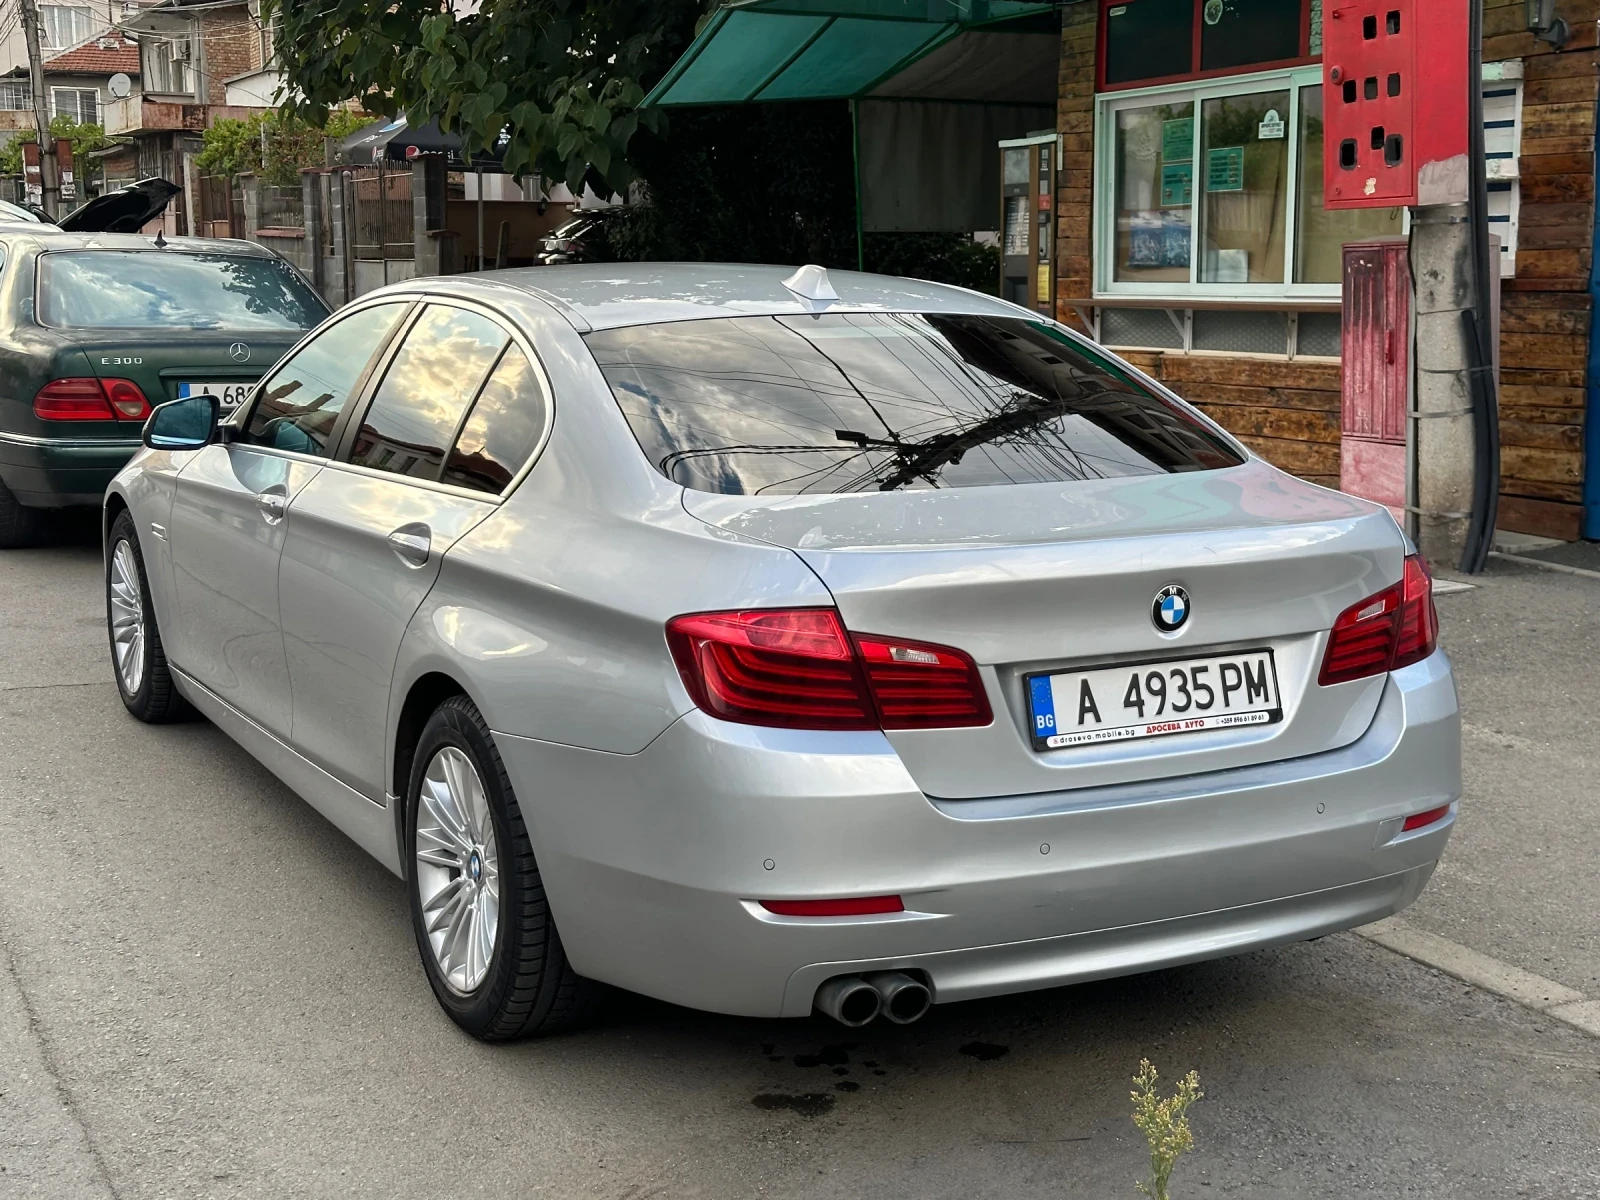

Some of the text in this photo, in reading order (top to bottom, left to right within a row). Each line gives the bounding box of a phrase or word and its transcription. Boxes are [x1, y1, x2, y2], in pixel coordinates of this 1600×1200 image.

[1078, 678, 1101, 725] A
[1037, 714, 1054, 729] BG
[1146, 722, 1181, 734] ДРОСЕВА
